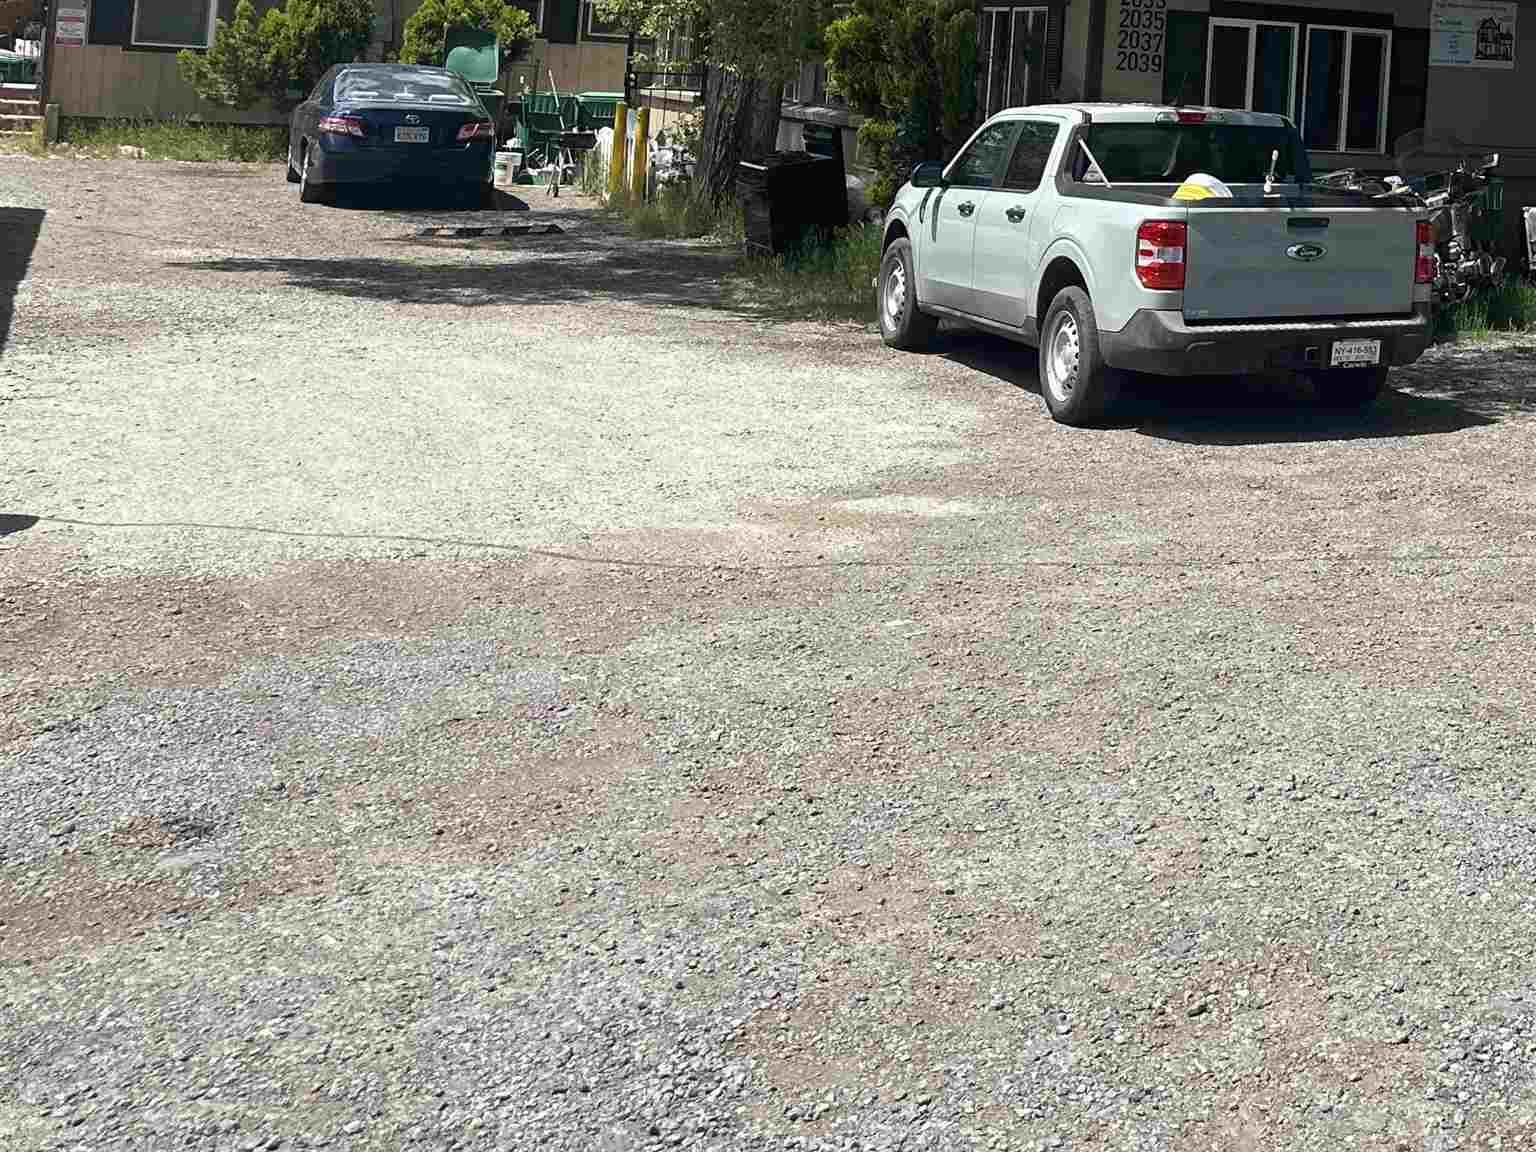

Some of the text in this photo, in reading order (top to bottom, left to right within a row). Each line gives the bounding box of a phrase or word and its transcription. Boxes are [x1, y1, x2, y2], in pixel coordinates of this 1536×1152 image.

[1119, 8, 1166, 31] 2035
[1118, 29, 1163, 53] 2037
[1116, 51, 1162, 73] 2039
